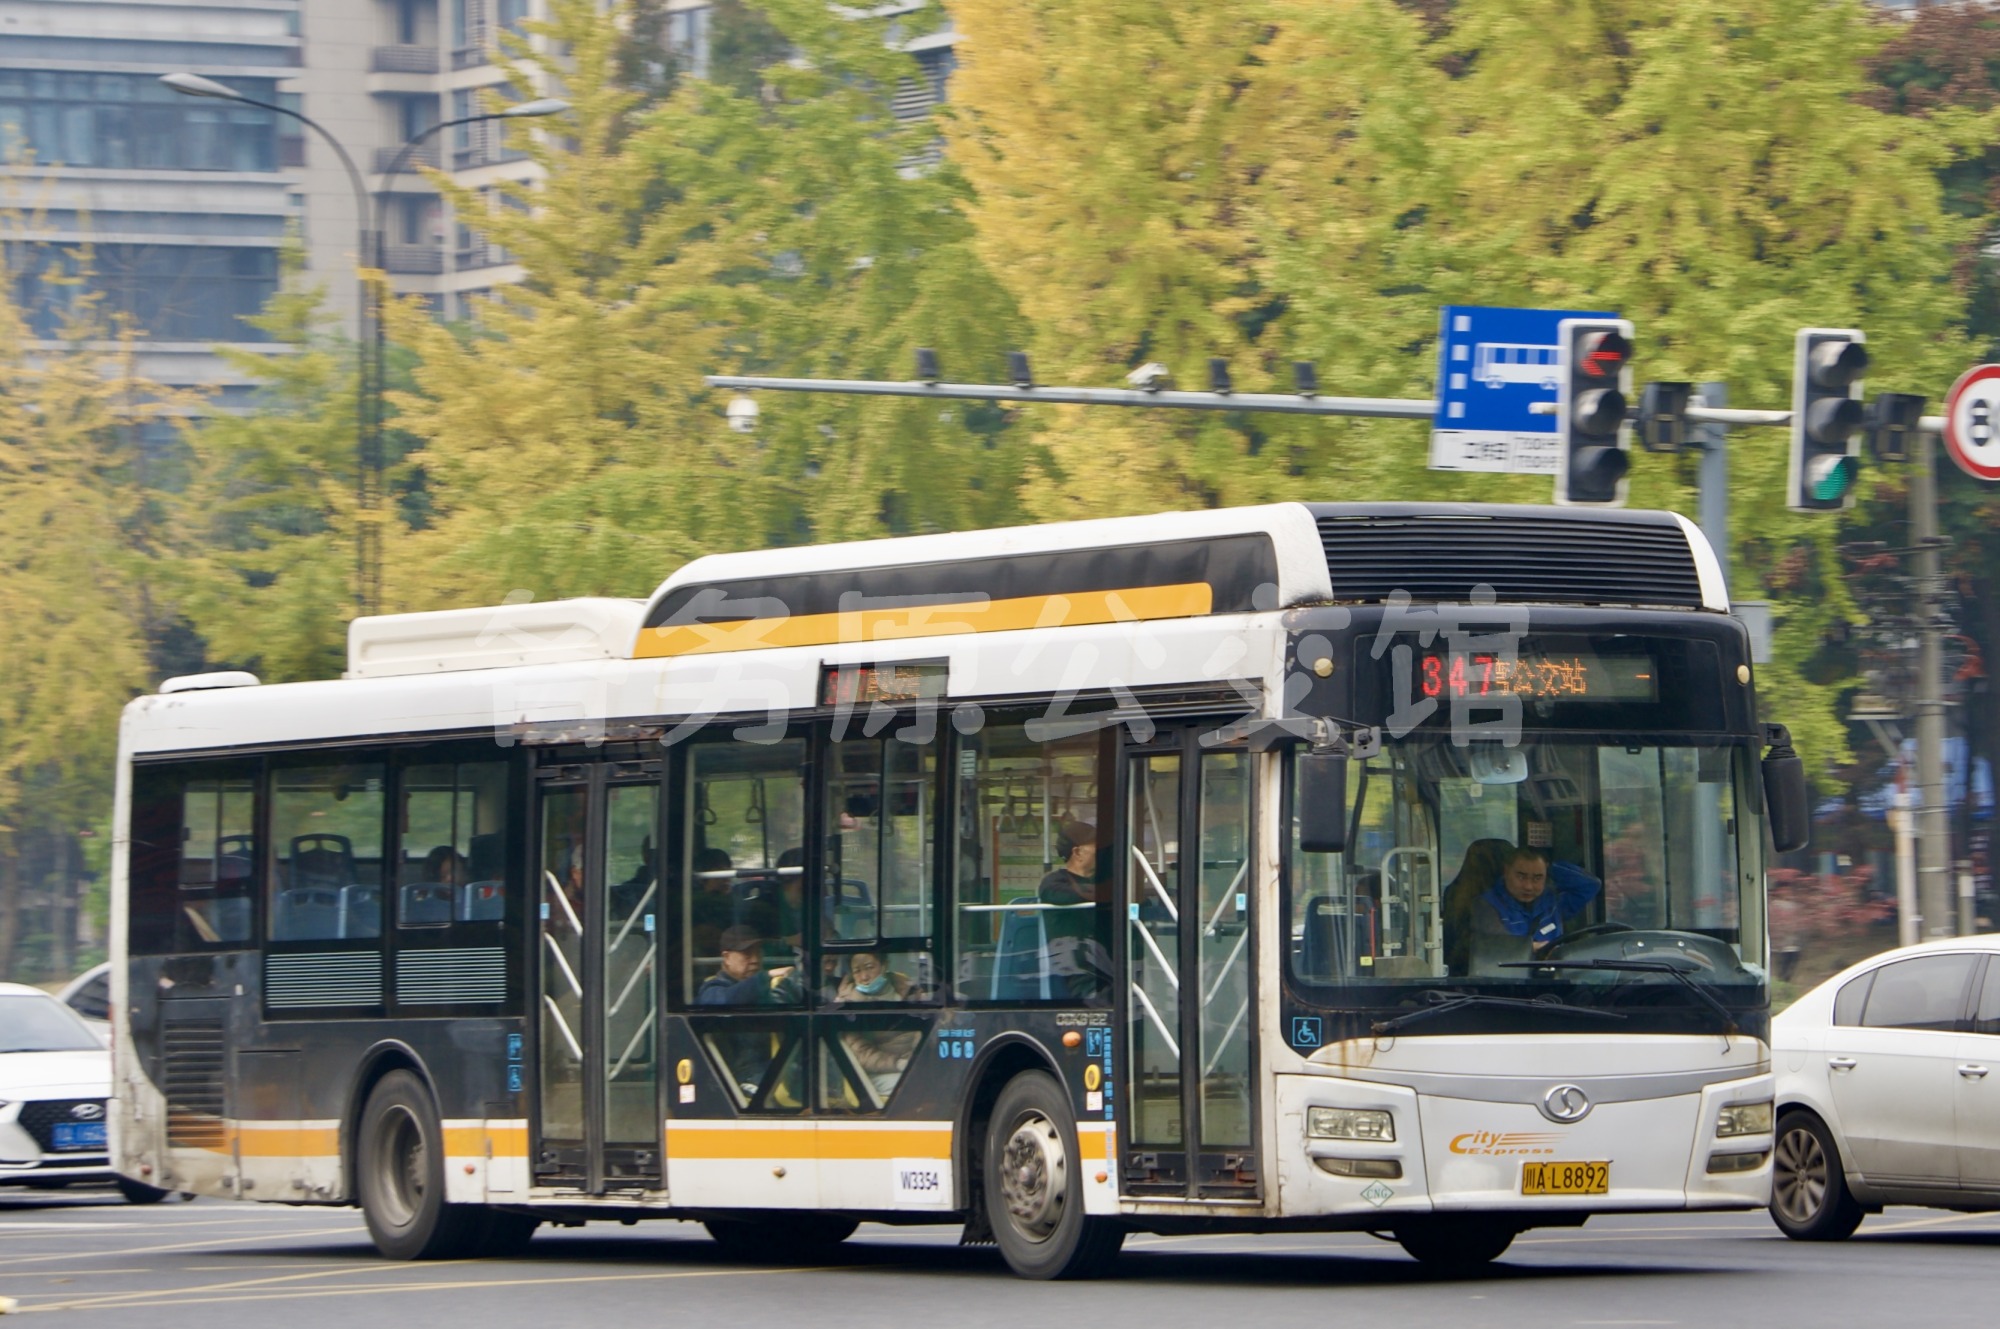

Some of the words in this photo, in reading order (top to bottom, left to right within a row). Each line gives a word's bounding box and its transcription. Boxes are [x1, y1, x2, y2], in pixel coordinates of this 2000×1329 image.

[1422, 656, 1493, 696] 347
[1449, 1130, 1501, 1154] City
[1468, 1147, 1554, 1156] Express
[901, 1170, 939, 1190] W3354
[1366, 1188, 1389, 1200] CNG
